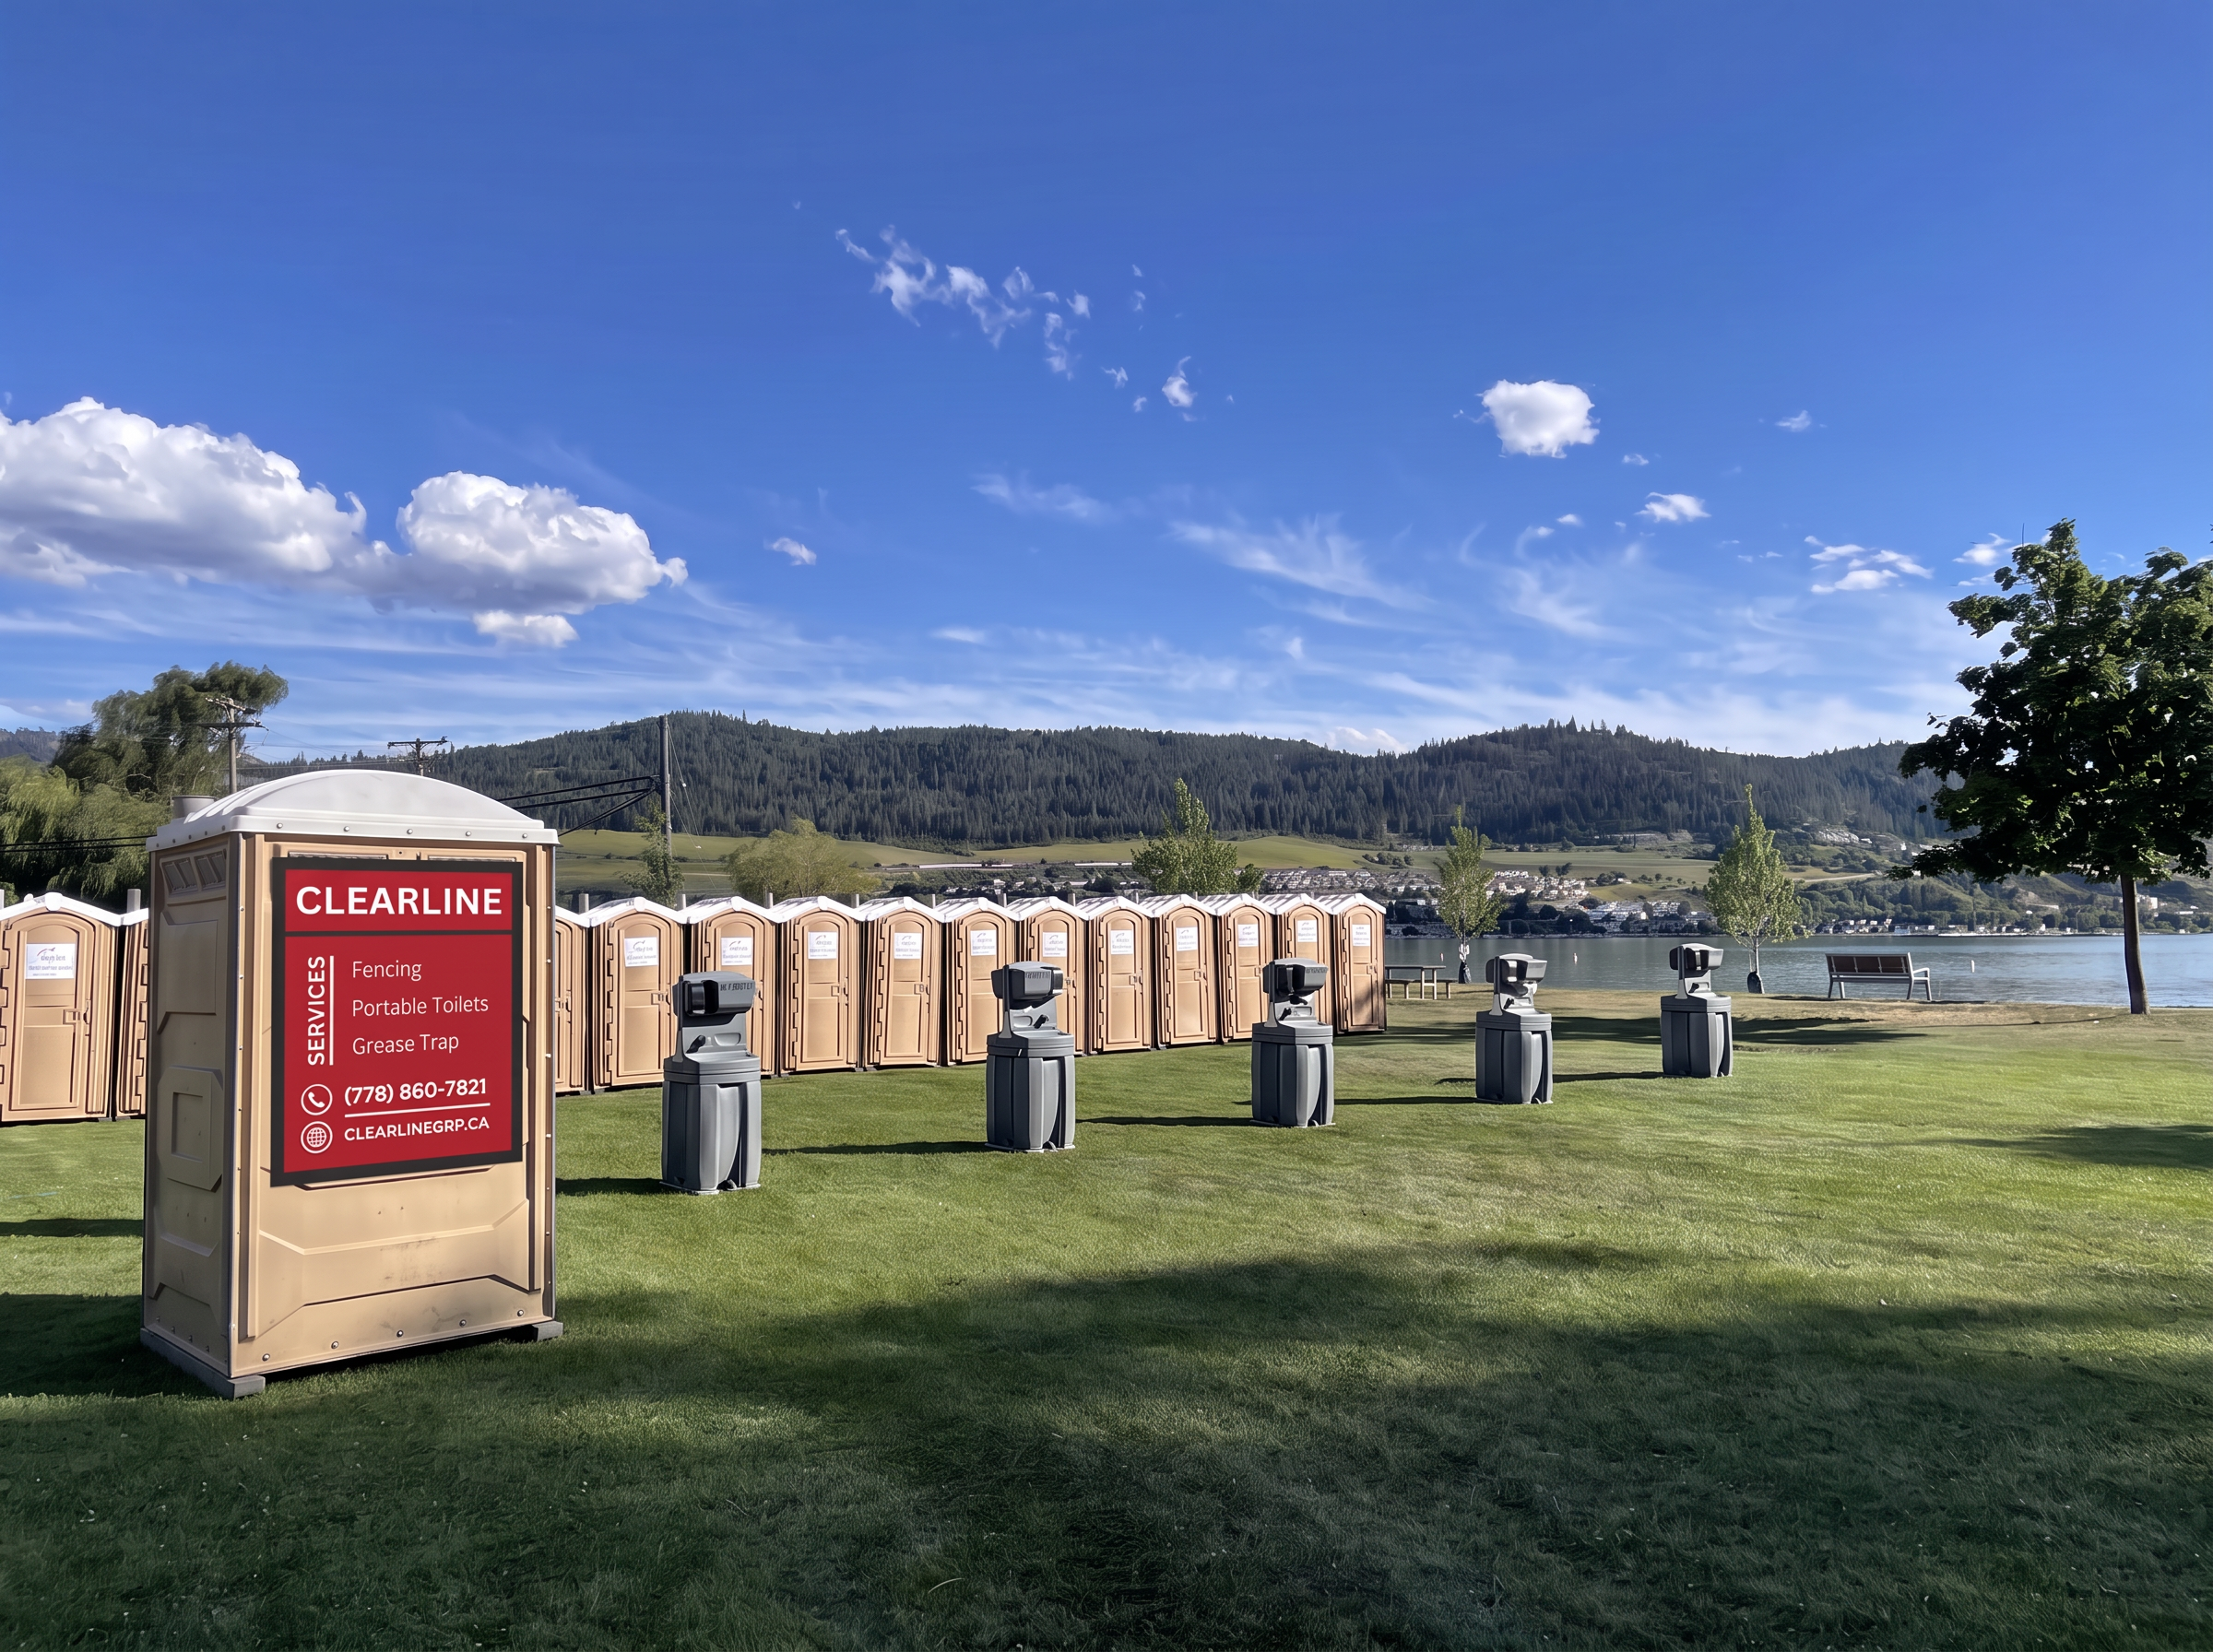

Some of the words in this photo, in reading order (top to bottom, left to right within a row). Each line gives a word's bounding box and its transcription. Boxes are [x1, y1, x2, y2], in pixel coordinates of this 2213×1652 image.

[296, 886, 503, 915] CLEARLINE
[353, 960, 422, 982] Fencing
[308, 957, 325, 1066] SERVICES
[353, 997, 427, 1017] Portable
[432, 996, 489, 1014] Toilets
[353, 1038, 415, 1056] Grease
[420, 1034, 459, 1054] Trap
[345, 1084, 394, 1107] (778)
[400, 1078, 486, 1101] 860-7821
[345, 1115, 490, 1141] CLEARLINEGRP.CA
